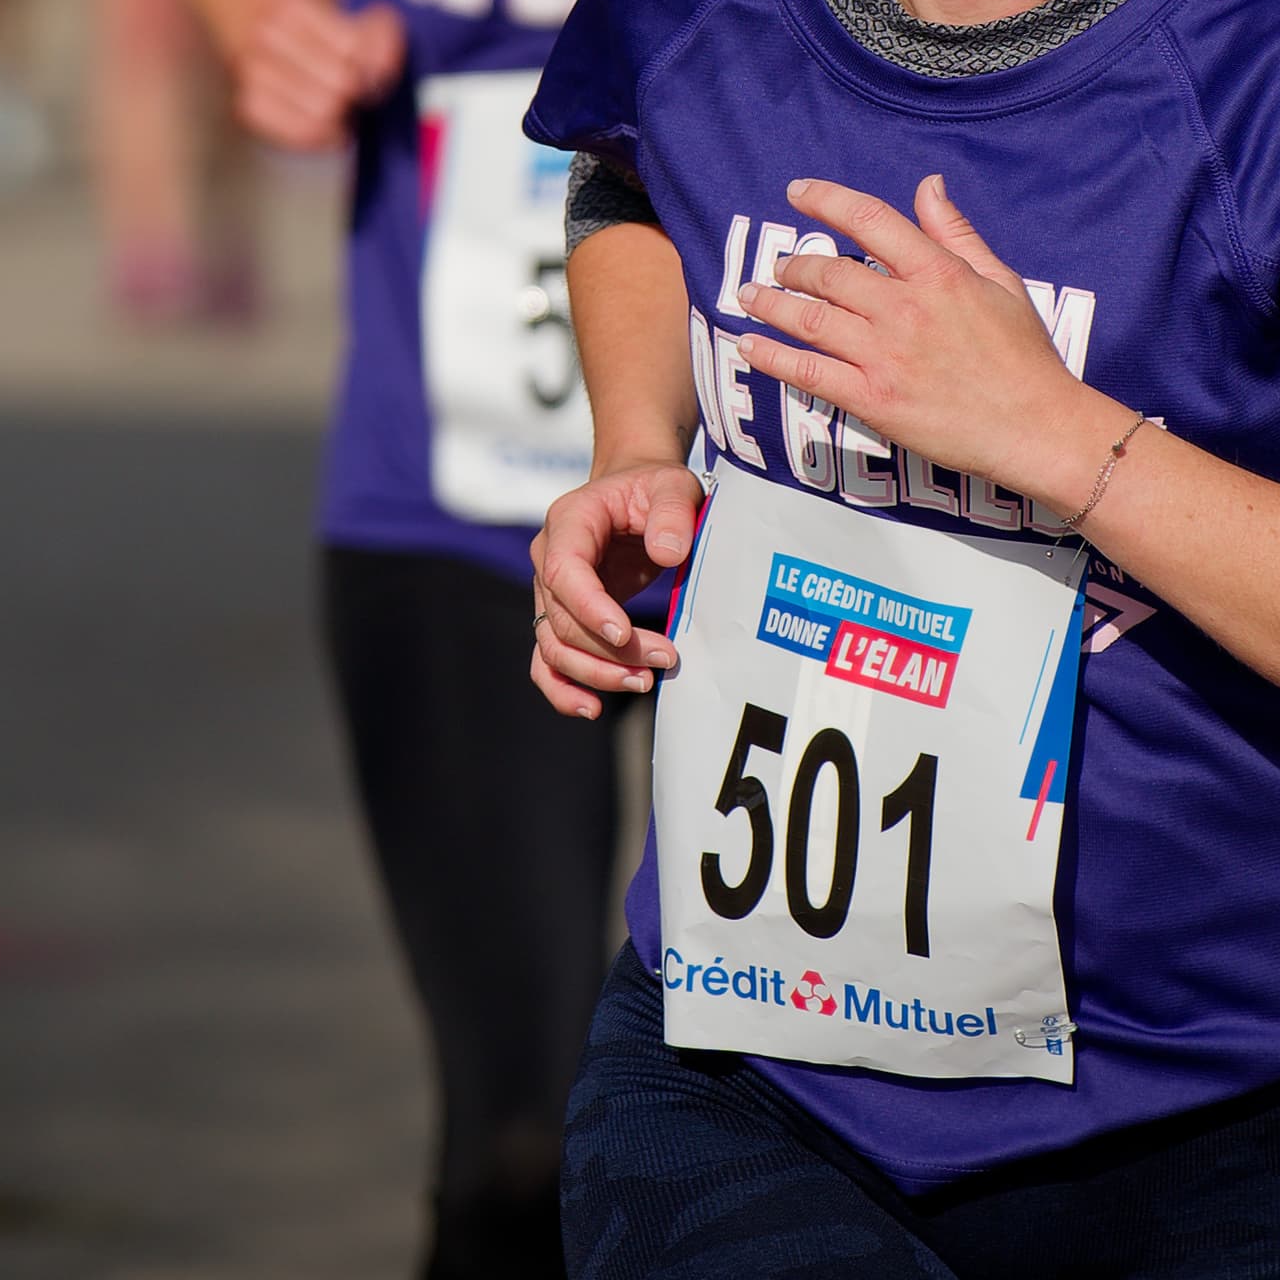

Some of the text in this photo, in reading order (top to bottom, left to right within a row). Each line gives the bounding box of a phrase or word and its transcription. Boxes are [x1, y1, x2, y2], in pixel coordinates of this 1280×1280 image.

[689, 304, 768, 471] DE
[764, 607, 831, 652] DONNE
[775, 564, 956, 642] LE CRÉDIT MUTUEL
[700, 701, 940, 960] 501
[664, 947, 787, 1007] Crédit
[843, 983, 999, 1038] Mutuel
